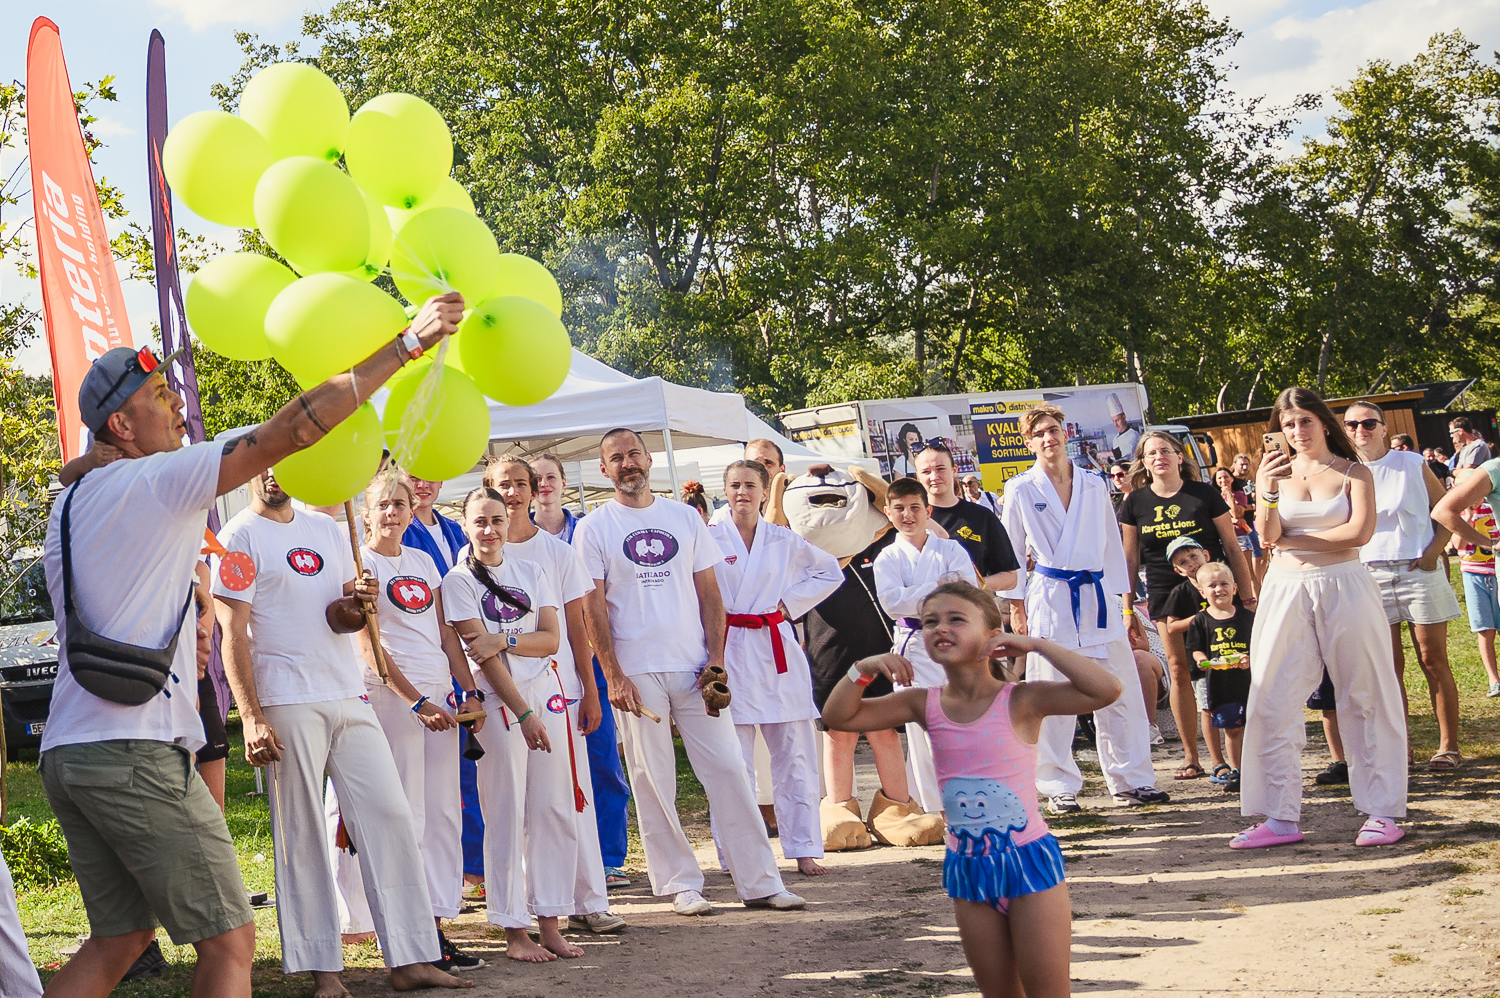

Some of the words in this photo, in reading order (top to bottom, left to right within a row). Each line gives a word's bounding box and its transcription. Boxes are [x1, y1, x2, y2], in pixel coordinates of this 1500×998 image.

[41, 169, 109, 362] nteria
[972, 404, 994, 414] makro
[1009, 401, 1035, 411] distribu
[986, 422, 1020, 435] KVALI
[990, 437, 998, 447] A
[991, 448, 1035, 458] SORTIMEN
[1153, 505, 1164, 522] I
[1141, 523, 1171, 534] Karate
[1172, 520, 1196, 529] Lions
[1155, 529, 1181, 538] Camp
[26, 665, 58, 677] IVEC
